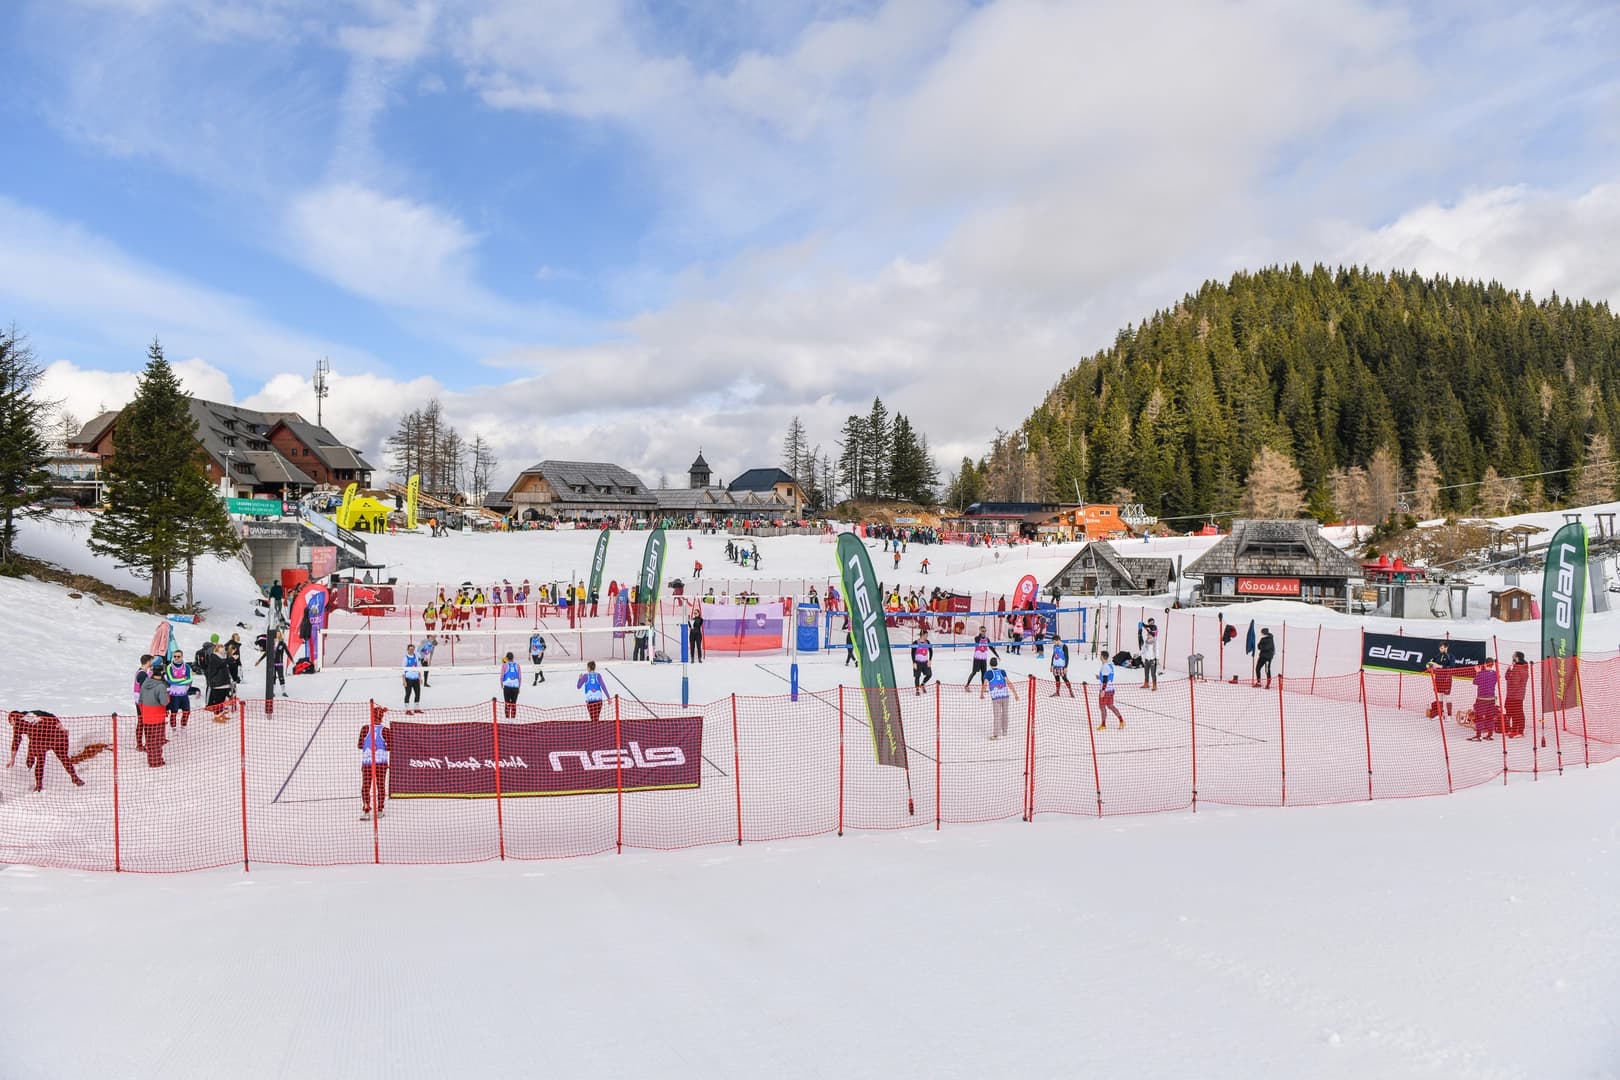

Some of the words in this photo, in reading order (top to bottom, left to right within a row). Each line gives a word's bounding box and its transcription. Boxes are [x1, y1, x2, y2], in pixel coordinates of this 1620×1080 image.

[595, 536, 607, 572] elan
[646, 538, 660, 589] elan
[1253, 582, 1299, 592] DOMŽALE
[1552, 543, 1576, 629] elan
[1368, 645, 1423, 663] elan
